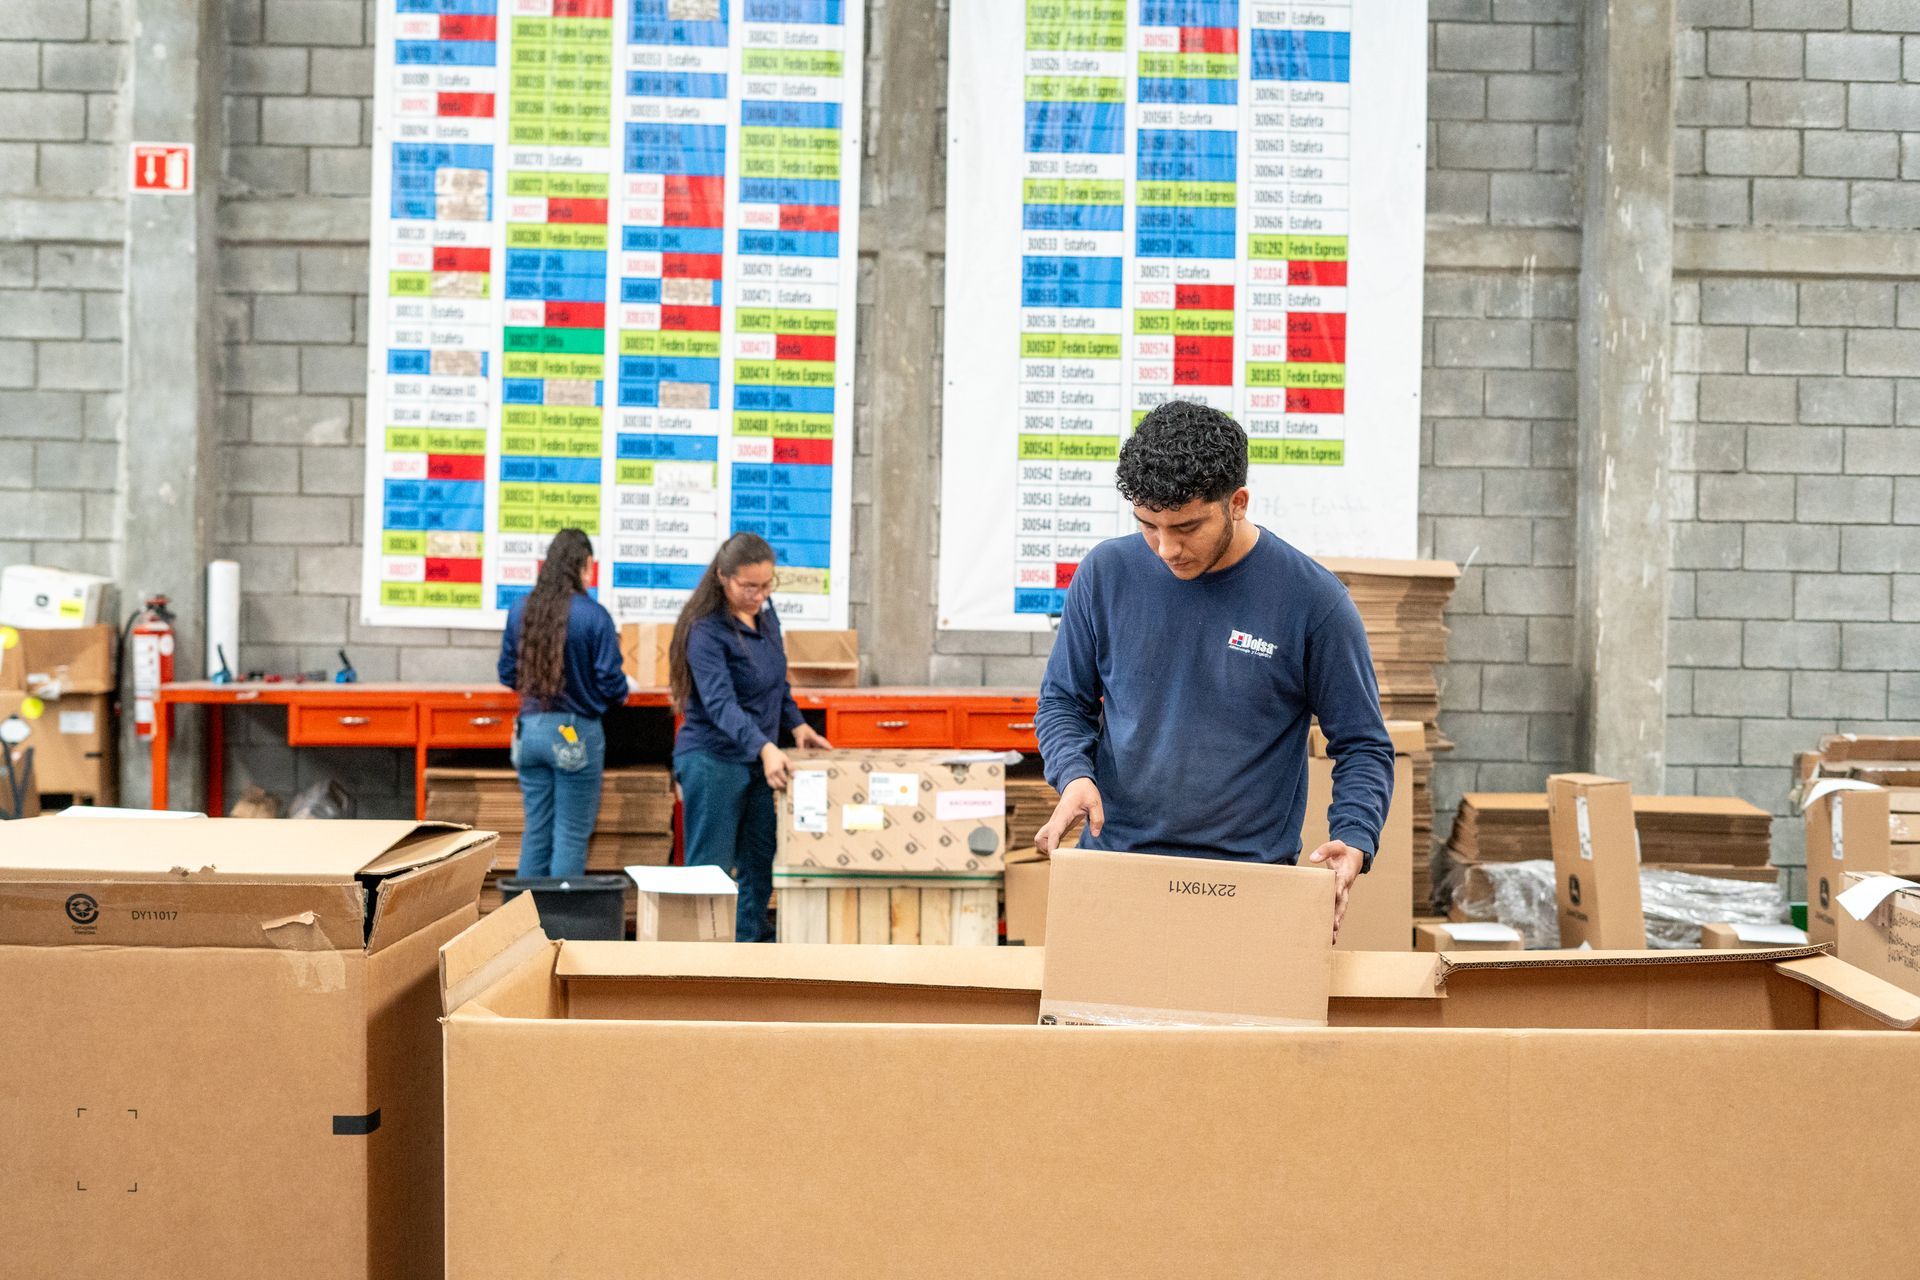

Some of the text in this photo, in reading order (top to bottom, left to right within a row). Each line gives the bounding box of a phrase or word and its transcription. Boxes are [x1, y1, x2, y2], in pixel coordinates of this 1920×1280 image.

[1291, 12, 1324, 25] Estafeta
[1179, 62, 1203, 74] Fedex
[1206, 62, 1236, 76] Express
[1290, 89, 1323, 102] Estafeta
[1178, 112, 1212, 125] Estafeta
[1290, 114, 1323, 127] Estafeta
[1290, 140, 1323, 153] Estafeta
[1064, 162, 1098, 175] Estafeta
[1254, 165, 1323, 178] 300604 Estafeta
[1064, 188, 1088, 200] Fedex
[1091, 188, 1121, 202] Express
[1177, 189, 1201, 201] Fedex
[1204, 189, 1234, 203] Express
[1254, 190, 1323, 204] 300605 Estafeta
[1064, 213, 1081, 226] DHL
[1177, 215, 1194, 228] DHL
[1254, 216, 1322, 229] 300606 Estafeta
[1028, 237, 1097, 251] 300533 Estafeta
[1177, 241, 1194, 254] DHL
[1253, 242, 1345, 257] 301292 Fedex Express
[778, 264, 811, 277] Estafeta
[1063, 264, 1080, 277] DHL
[1140, 265, 1210, 280] 300571 Estafeta
[1288, 267, 1312, 279] Senda
[777, 290, 811, 303] Estafeta
[1063, 290, 1080, 303] DHL
[1176, 293, 1200, 305] Senda
[1288, 294, 1321, 307] Estafeta
[776, 316, 801, 328] Fedex
[803, 316, 834, 330] Express
[1026, 315, 1096, 329] 300536 Estafeta
[1139, 316, 1232, 332] 300573 Fedex Express
[1288, 319, 1312, 331] Senda
[661, 337, 718, 353] Fedex Express
[777, 342, 801, 354] Senda
[1026, 340, 1119, 355] 300537 Fedex Express
[1139, 342, 1200, 355] 300574 Senda
[1287, 345, 1311, 358] Senda
[544, 360, 600, 376] Fedex Express
[740, 366, 832, 382] 300474 Fedex Express
[1026, 365, 1095, 379] 300538 Estafeta
[1138, 367, 1198, 381] 300575 Senda
[1287, 371, 1311, 383] Fedex
[1314, 371, 1344, 385] Express
[1025, 391, 1094, 405] 300539 Estafeta
[1286, 396, 1310, 408] Senda
[543, 411, 599, 427] Fedex Express
[658, 416, 691, 429] Estafeta
[1024, 416, 1094, 430] 300540 Estafeta
[774, 420, 798, 432] Fedex
[800, 420, 831, 434] Express
[1250, 420, 1319, 434] 301858 Estafeta
[774, 446, 798, 458] Senda
[1024, 441, 1117, 456] 300541 Fedex Express
[1284, 447, 1308, 460] Fedex
[1311, 448, 1341, 461] Express
[772, 471, 790, 484] DHL
[1023, 467, 1092, 481] 300542 Estafeta
[656, 494, 689, 507] Estafeta
[1022, 492, 1092, 506] 300543 Estafeta
[655, 520, 688, 532] Estafeta
[1022, 518, 1091, 532] 300544 Estafeta
[654, 546, 688, 559] Estafeta
[1020, 543, 1050, 556] 300545
[1020, 569, 1050, 582] 300546
[424, 589, 448, 601] Fedex
[1169, 880, 1236, 898] 22X19X11
[131, 910, 178, 921] DY11017
